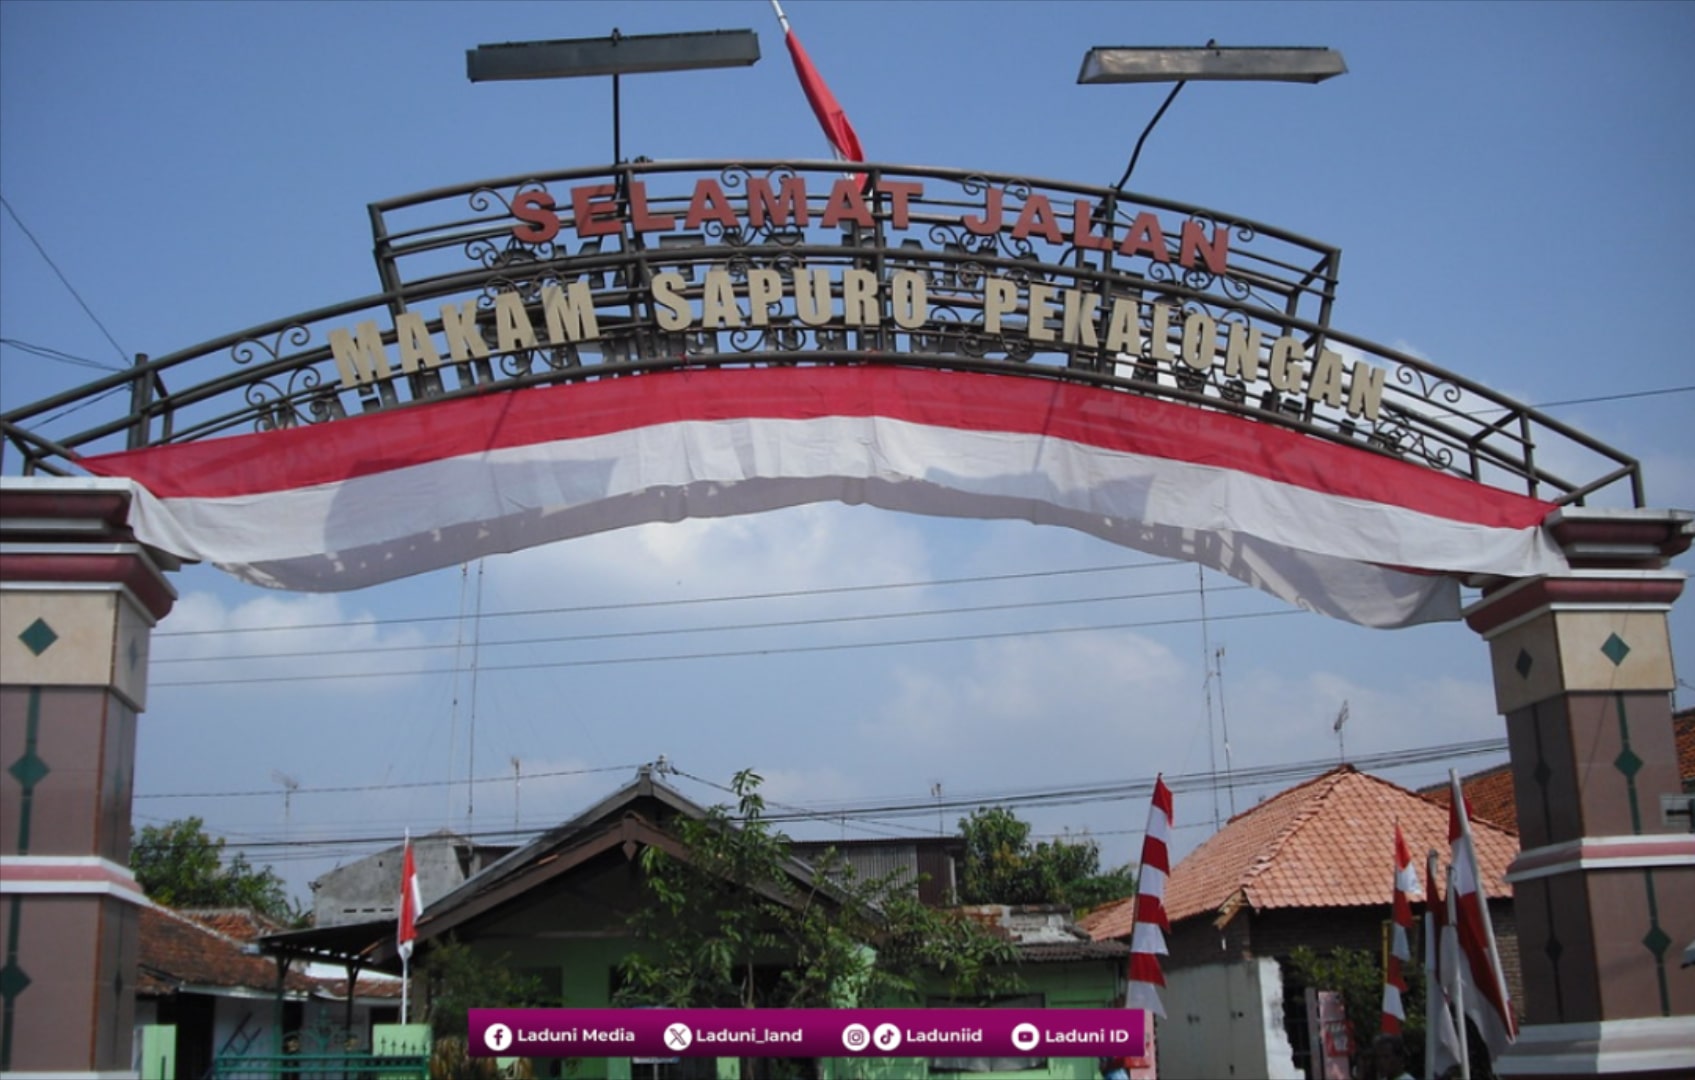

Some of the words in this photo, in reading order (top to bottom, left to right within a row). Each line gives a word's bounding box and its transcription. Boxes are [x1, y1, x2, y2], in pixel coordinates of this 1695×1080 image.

[512, 178, 923, 244] SELAMAT
[961, 188, 1230, 275] JALAN
[327, 281, 600, 389] MAKAM
[651, 268, 928, 332] SAPURO
[983, 276, 1387, 422] PEKALONGAN
